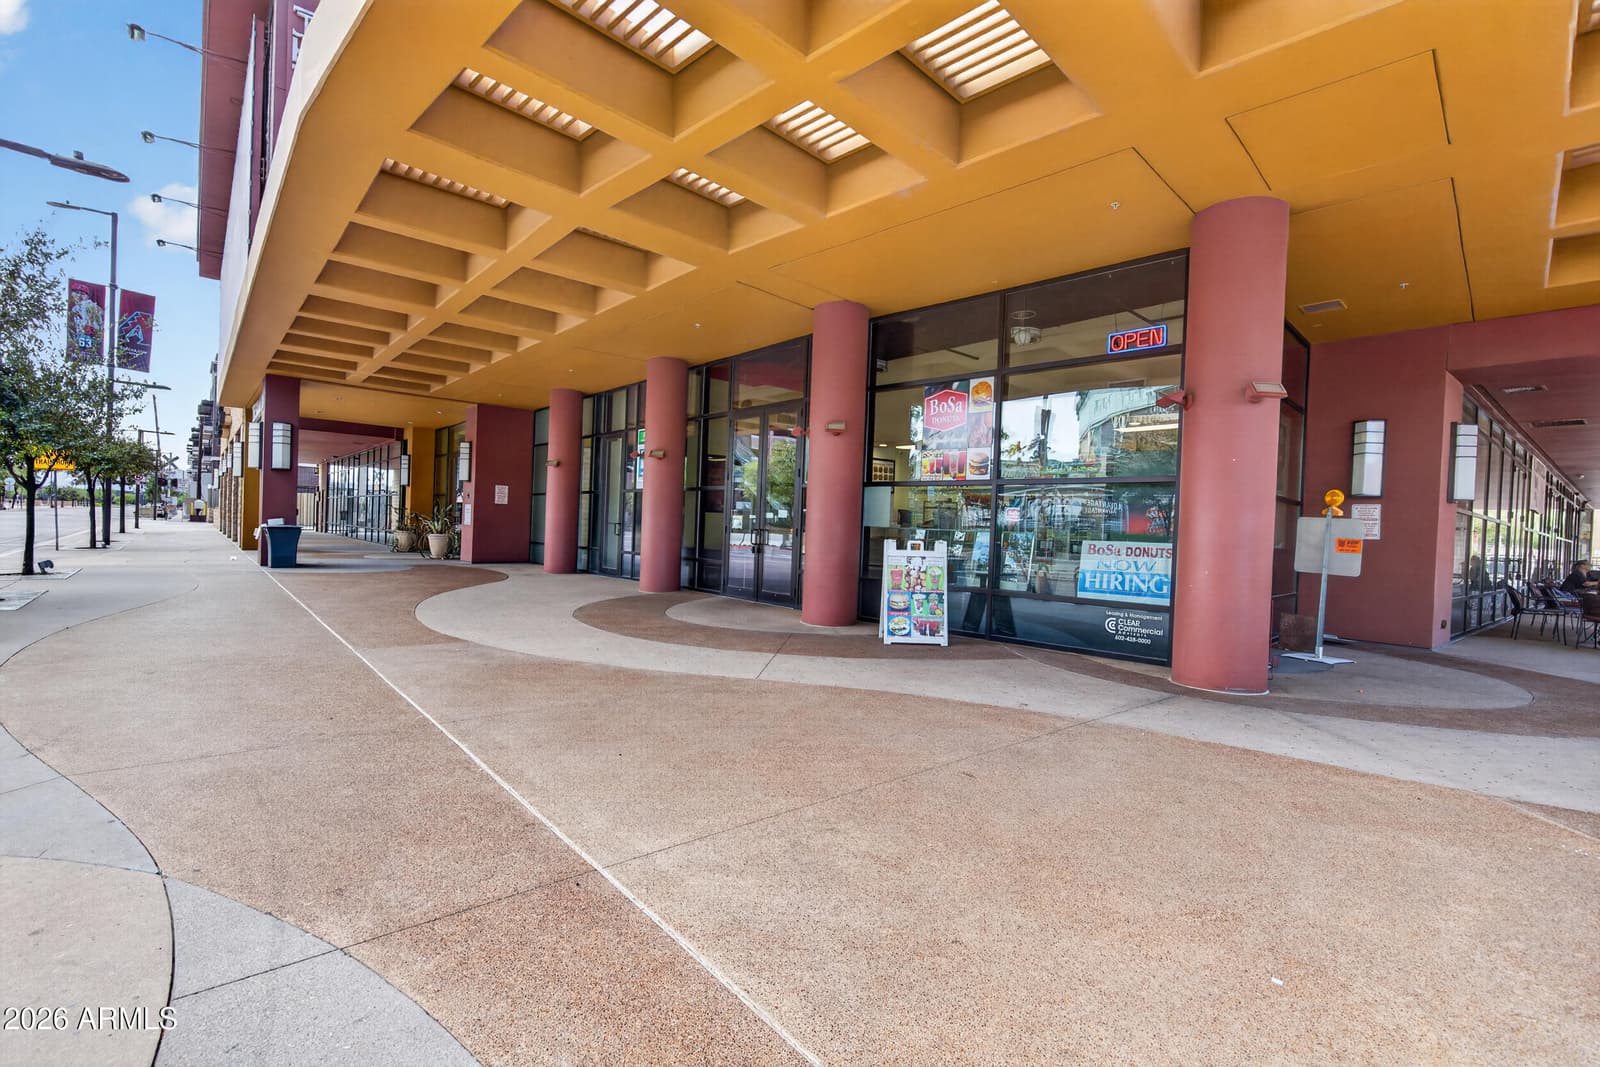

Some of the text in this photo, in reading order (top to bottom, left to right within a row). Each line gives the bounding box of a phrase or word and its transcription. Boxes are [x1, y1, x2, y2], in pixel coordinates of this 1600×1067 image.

[79, 337, 92, 348] 63
[1111, 327, 1163, 351] OPEN
[930, 396, 963, 416] BoSa
[1087, 543, 1173, 559] BoSa DONUTS
[1096, 559, 1157, 572] NOW
[1085, 571, 1169, 594] HIRING
[1118, 618, 1141, 627] CLEAR
[1117, 624, 1164, 636] Commercial
